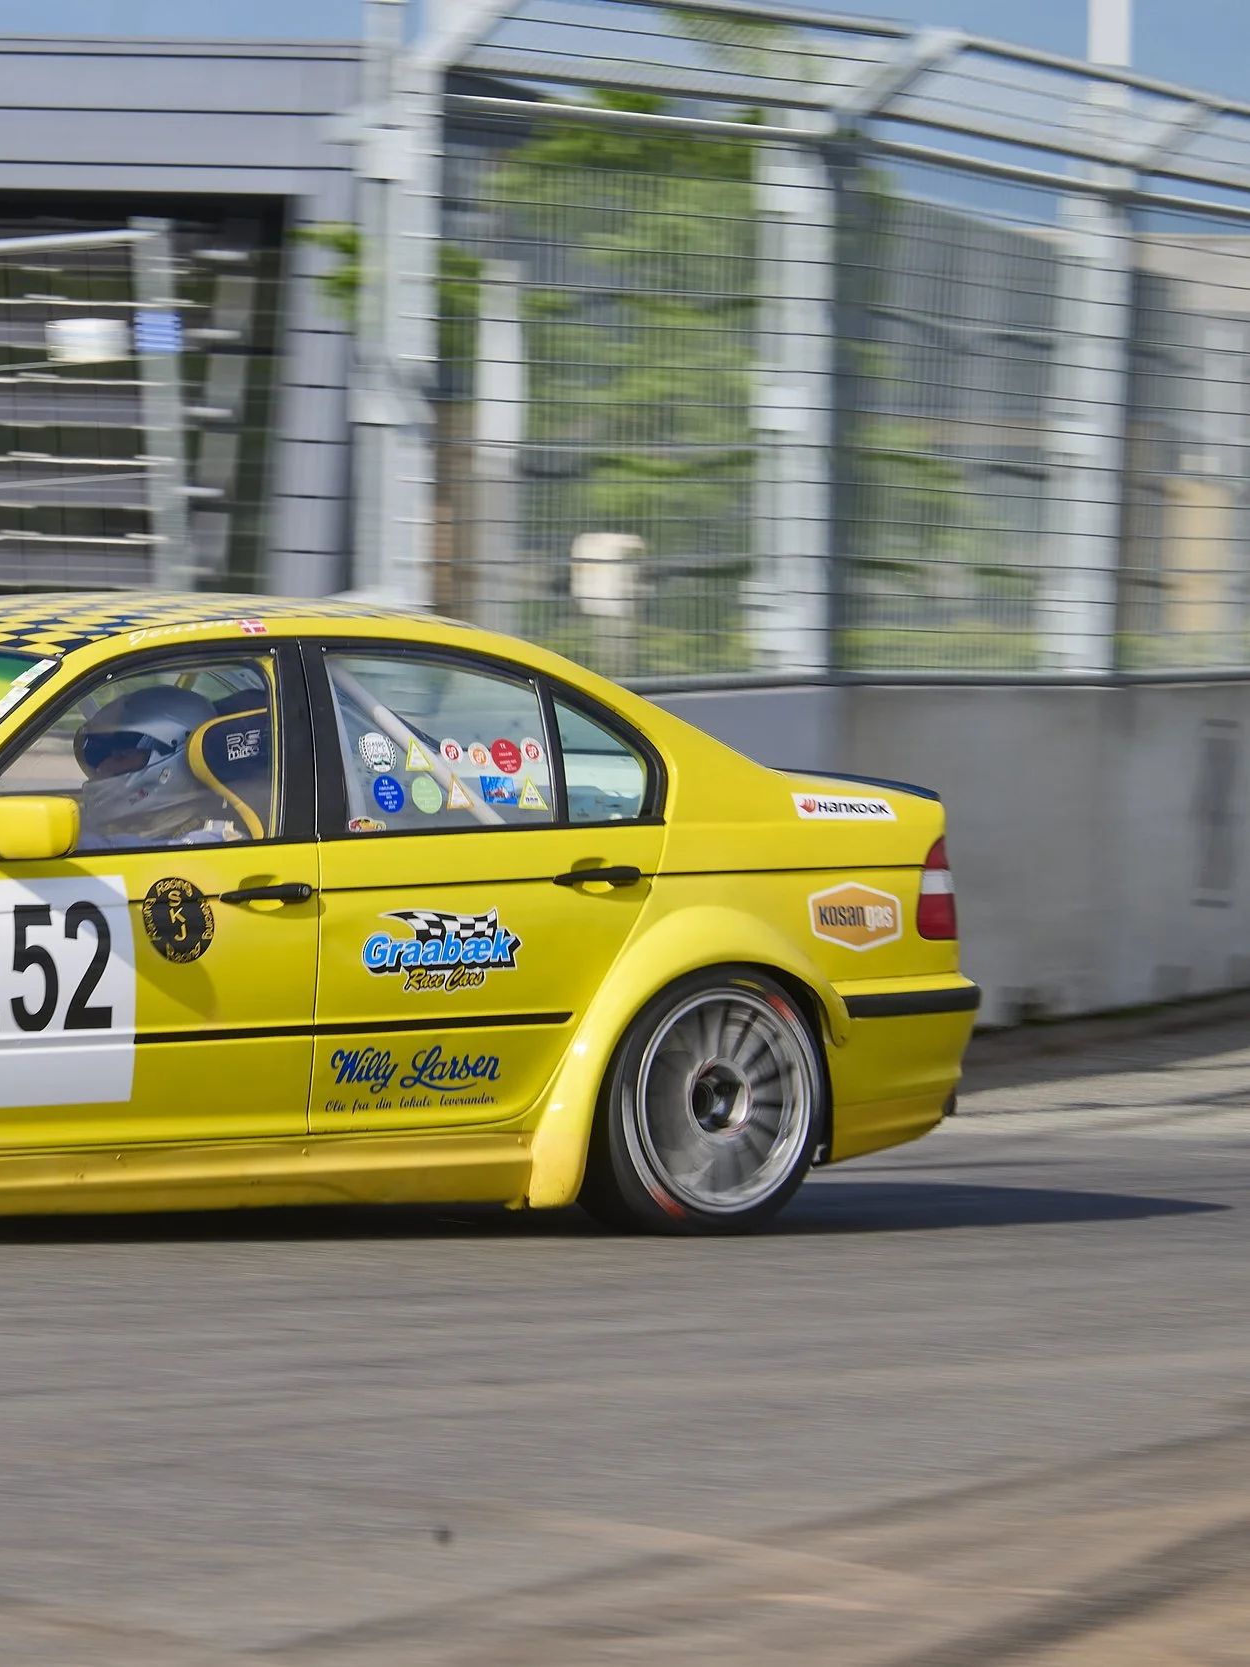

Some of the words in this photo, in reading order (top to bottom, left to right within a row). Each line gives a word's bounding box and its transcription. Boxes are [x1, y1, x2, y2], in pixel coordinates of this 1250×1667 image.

[155, 879, 194, 897] Racing
[363, 929, 516, 967] Graabæk
[404, 967, 445, 990] Race
[445, 965, 485, 992] Cars
[330, 1045, 399, 1095] Willy
[399, 1044, 501, 1092] Larsen
[351, 1098, 369, 1115] fra
[375, 1097, 393, 1110] din
